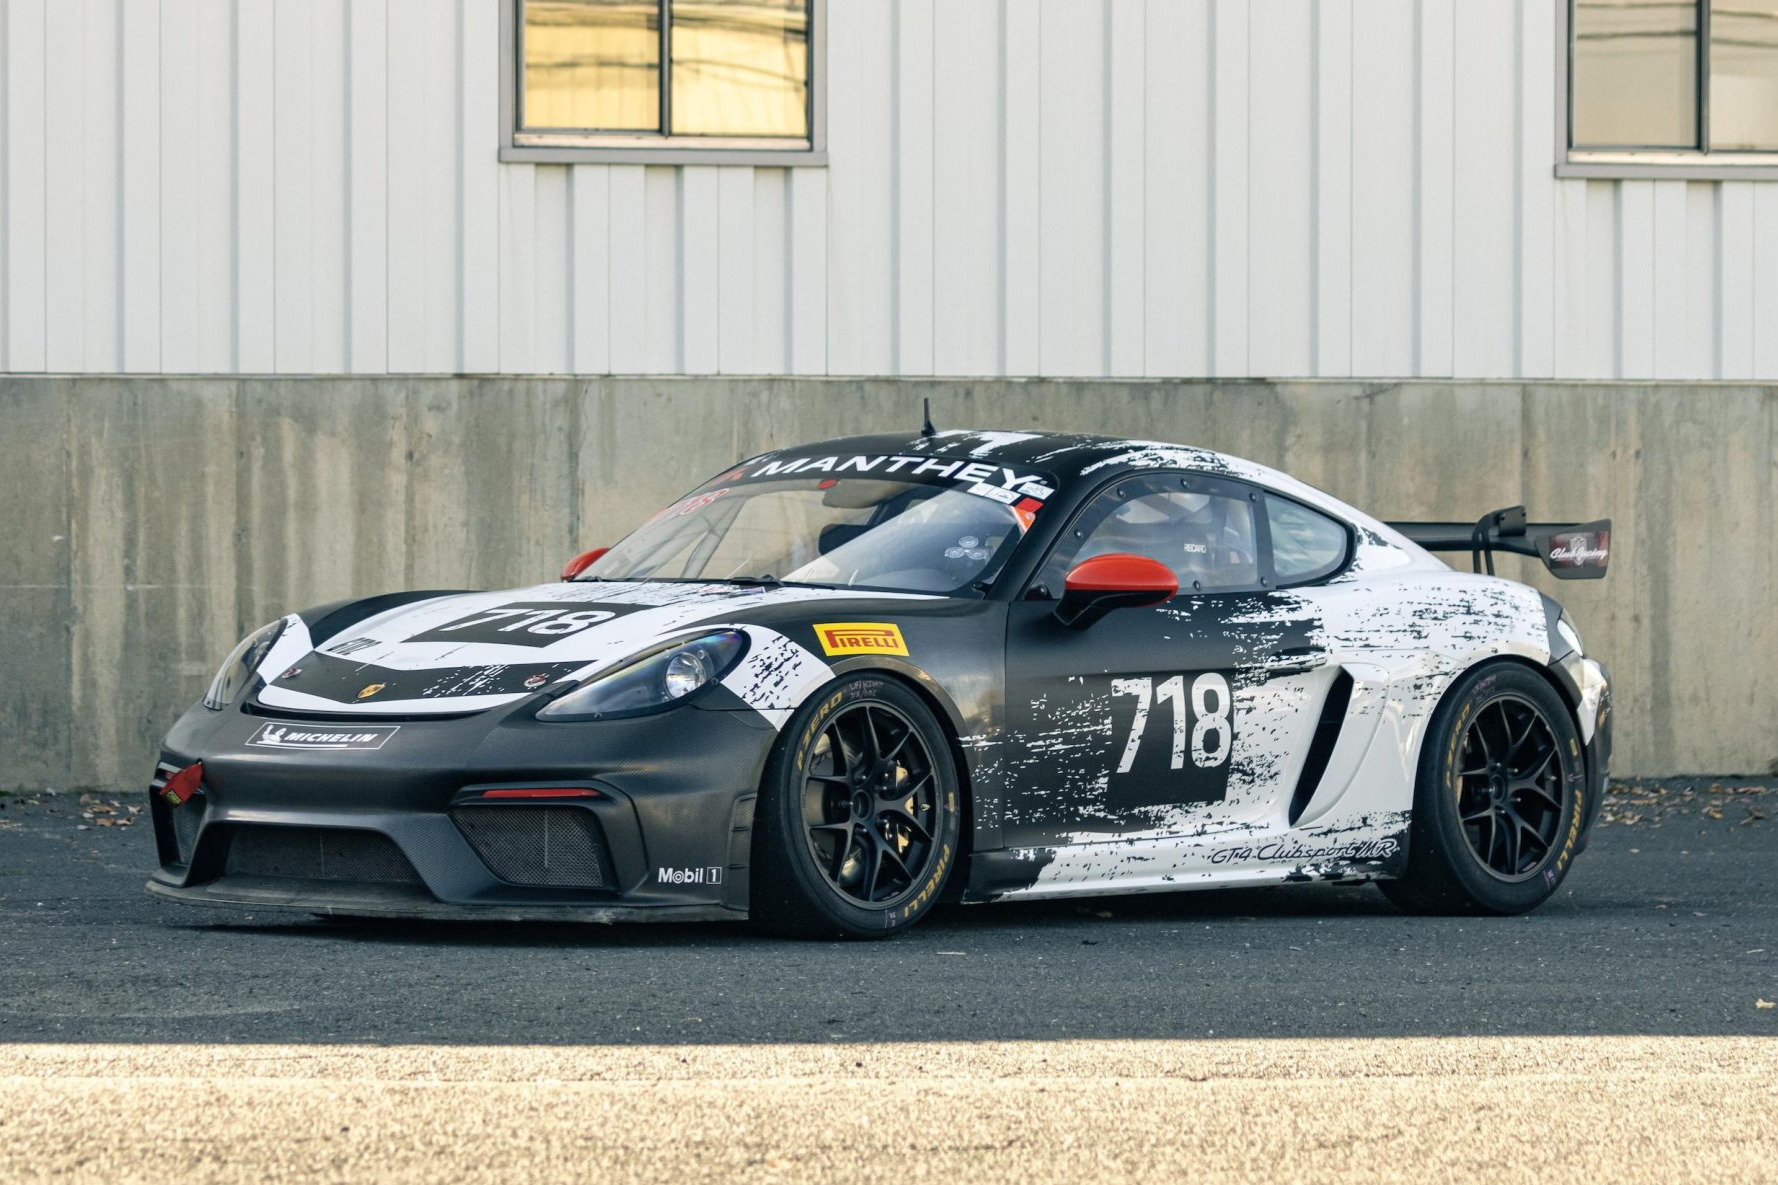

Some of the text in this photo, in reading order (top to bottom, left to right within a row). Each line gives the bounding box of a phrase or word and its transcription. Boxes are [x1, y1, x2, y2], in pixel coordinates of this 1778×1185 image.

[751, 455, 1043, 490] MANTHEY
[439, 608, 616, 635] 718
[824, 629, 899, 648] PIRELLI
[1111, 672, 1232, 774] 718
[285, 732, 378, 743] MICHELIN
[658, 867, 704, 883] Mobil
[903, 843, 950, 918] PIRELLI
